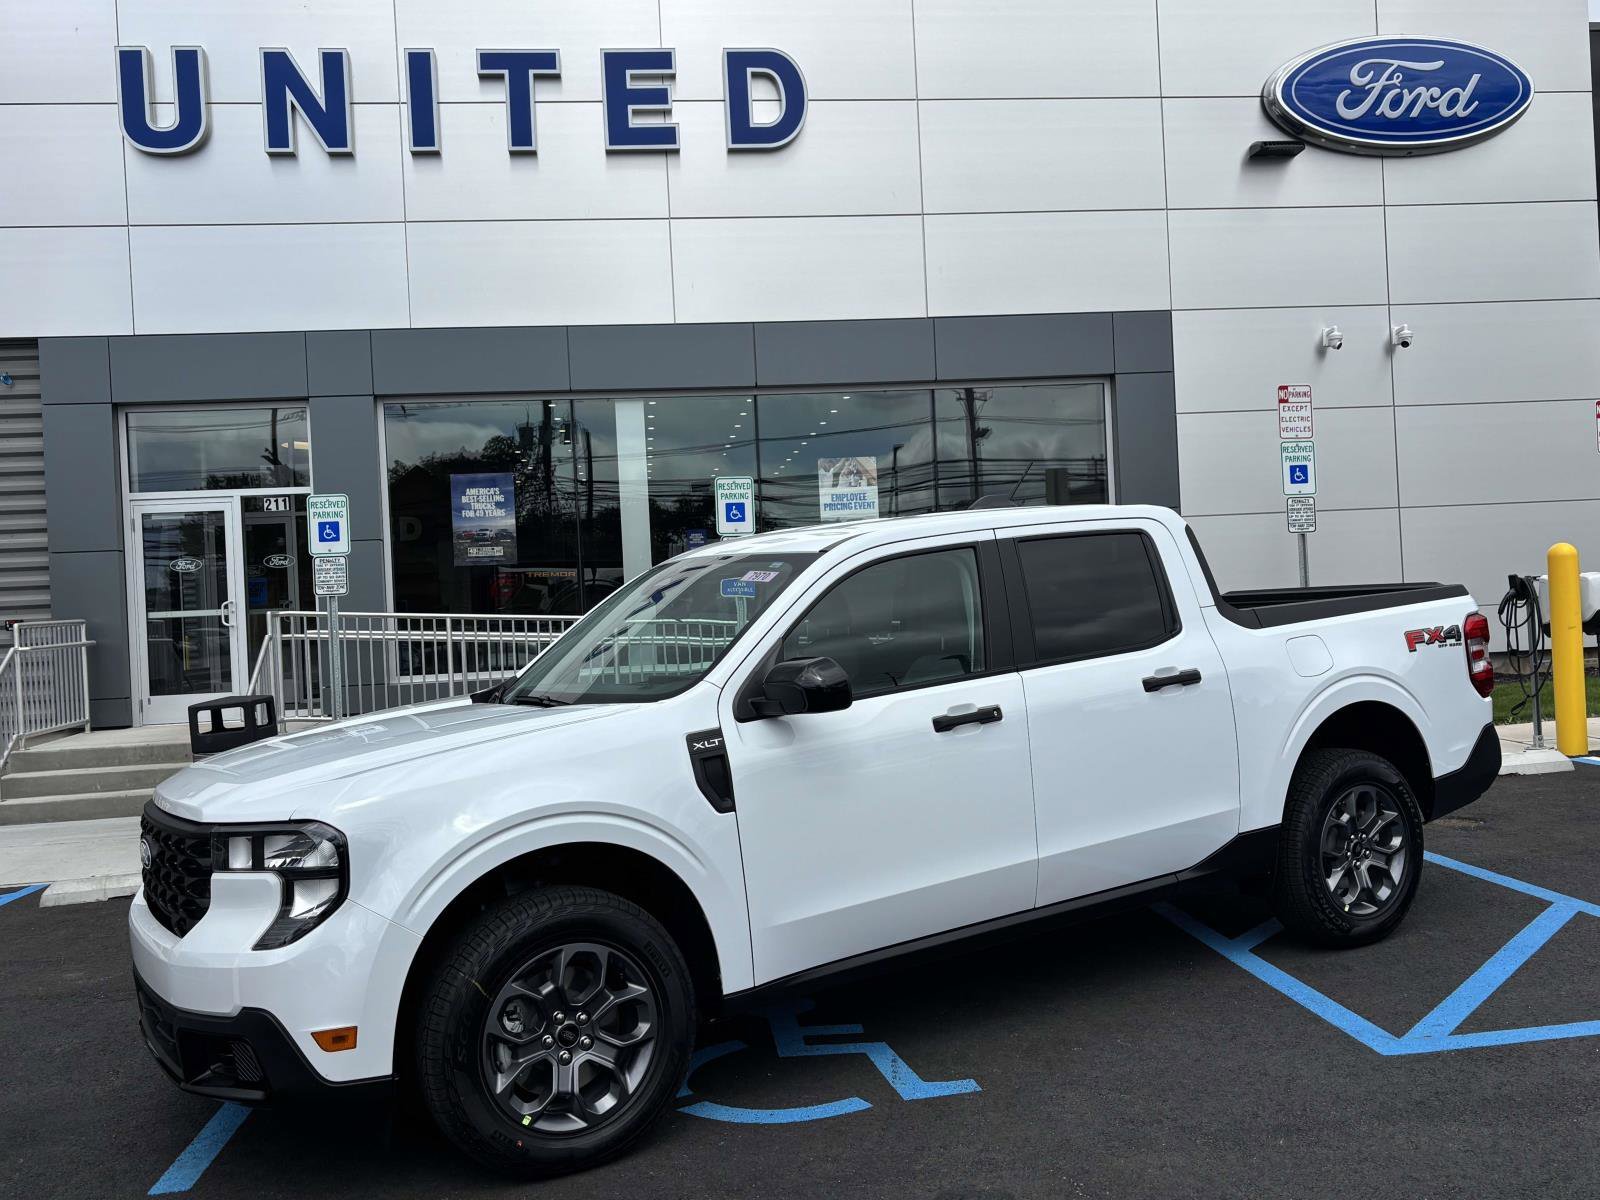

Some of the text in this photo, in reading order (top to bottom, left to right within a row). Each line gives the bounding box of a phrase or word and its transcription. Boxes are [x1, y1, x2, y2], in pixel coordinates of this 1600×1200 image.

[1336, 58, 1482, 121] Ford
[114, 45, 808, 157] UNITED
[1279, 389, 1311, 400] NO PARKING
[1282, 405, 1308, 413] EXCEPT
[1282, 445, 1312, 453] RESERVED
[1284, 455, 1311, 463] PARKING
[718, 482, 751, 491] RESERVED
[465, 487, 500, 496] AMERICA'S
[720, 492, 749, 500] PARKING
[461, 495, 505, 503] BEST-SELLING
[831, 492, 868, 502] EMPLOYEE
[264, 498, 289, 511] 211
[310, 500, 346, 509] RESERVED
[470, 502, 496, 510] TRUCKS
[823, 501, 876, 511] PRICING EVENT
[313, 510, 344, 519] PARKING
[462, 510, 475, 518] FOR
[485, 508, 506, 517] YEARS
[1404, 624, 1462, 653] FX4
[693, 737, 723, 750] XLT
